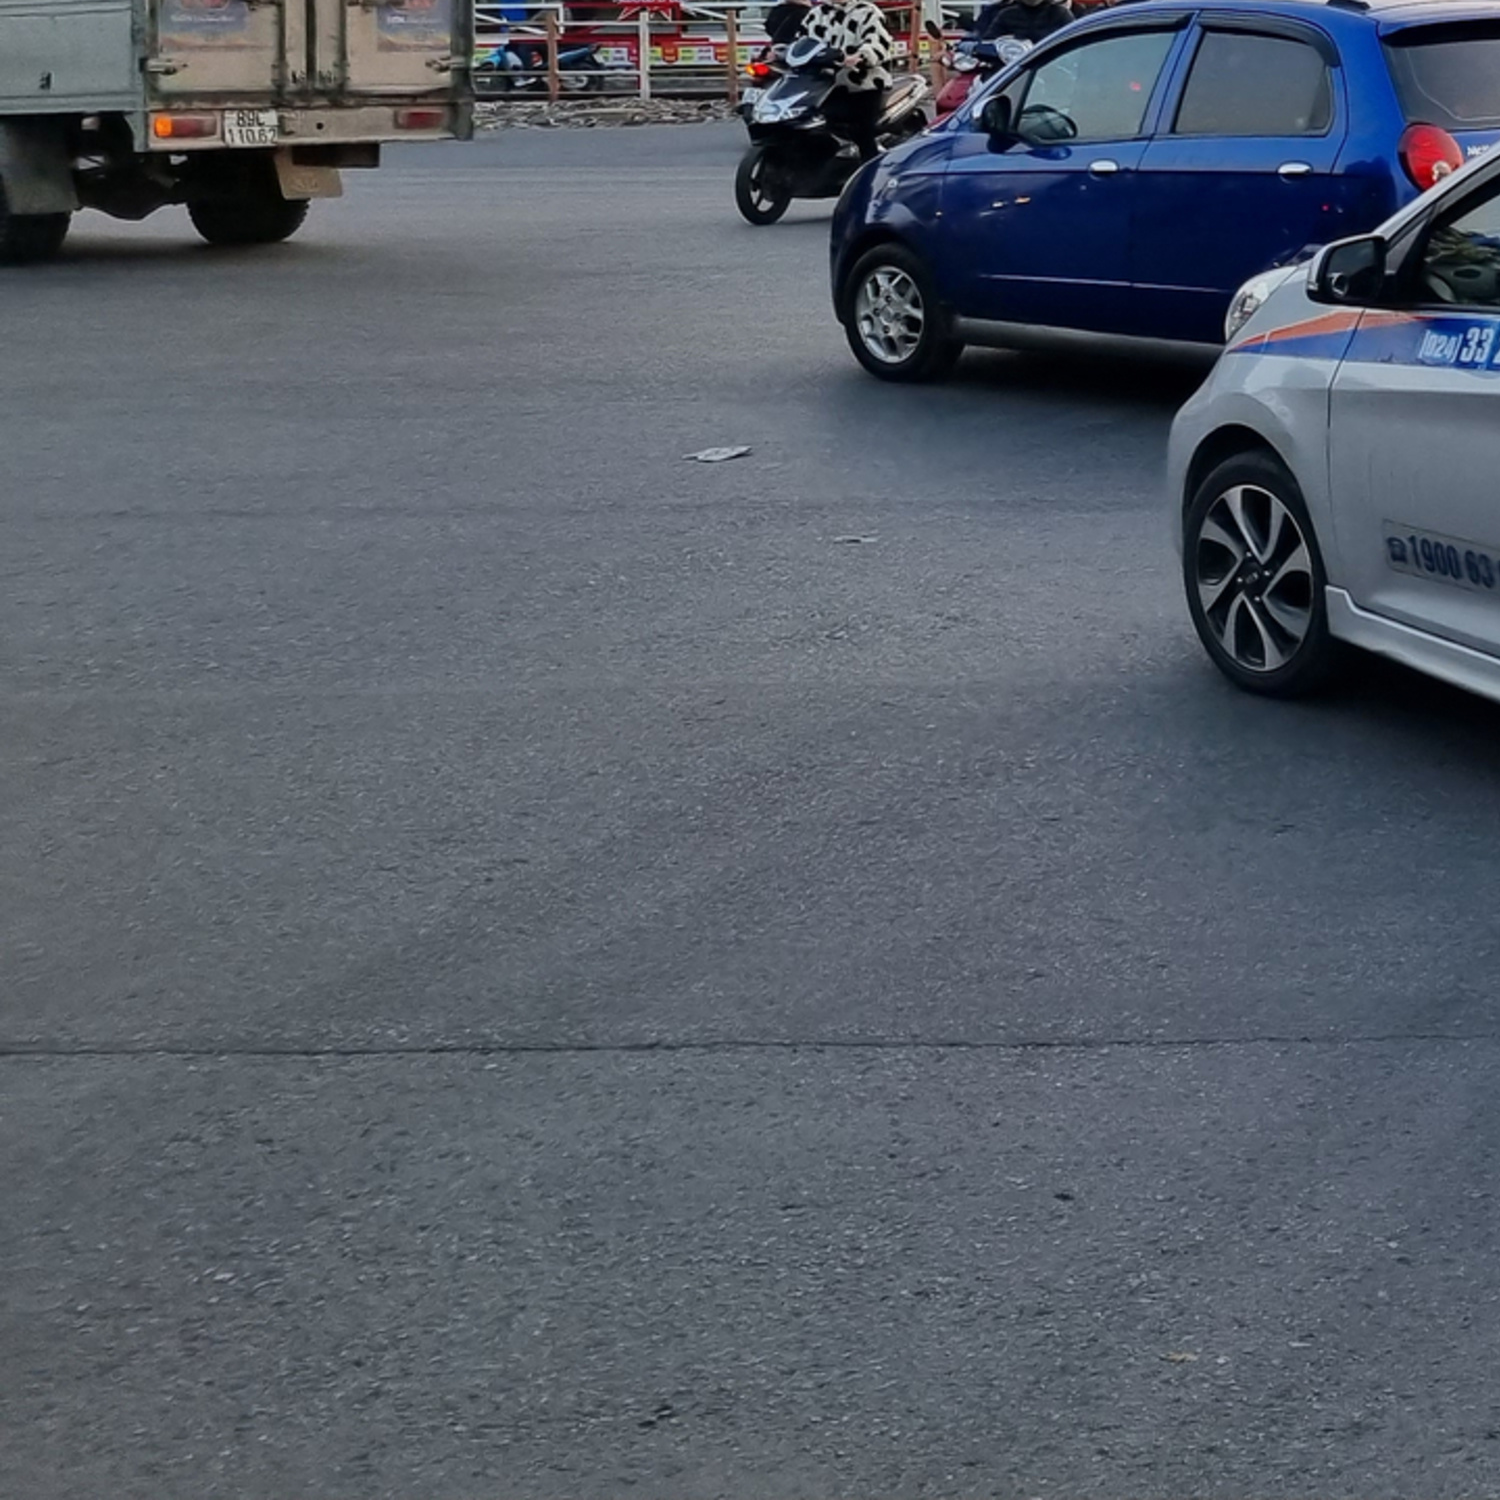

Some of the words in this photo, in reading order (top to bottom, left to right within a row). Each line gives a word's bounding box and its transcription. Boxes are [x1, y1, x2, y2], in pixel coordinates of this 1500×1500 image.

[236, 110, 265, 128] 89C
[1459, 326, 1495, 363] 33
[1407, 534, 1462, 580] 1900
[1465, 550, 1496, 589] 63
